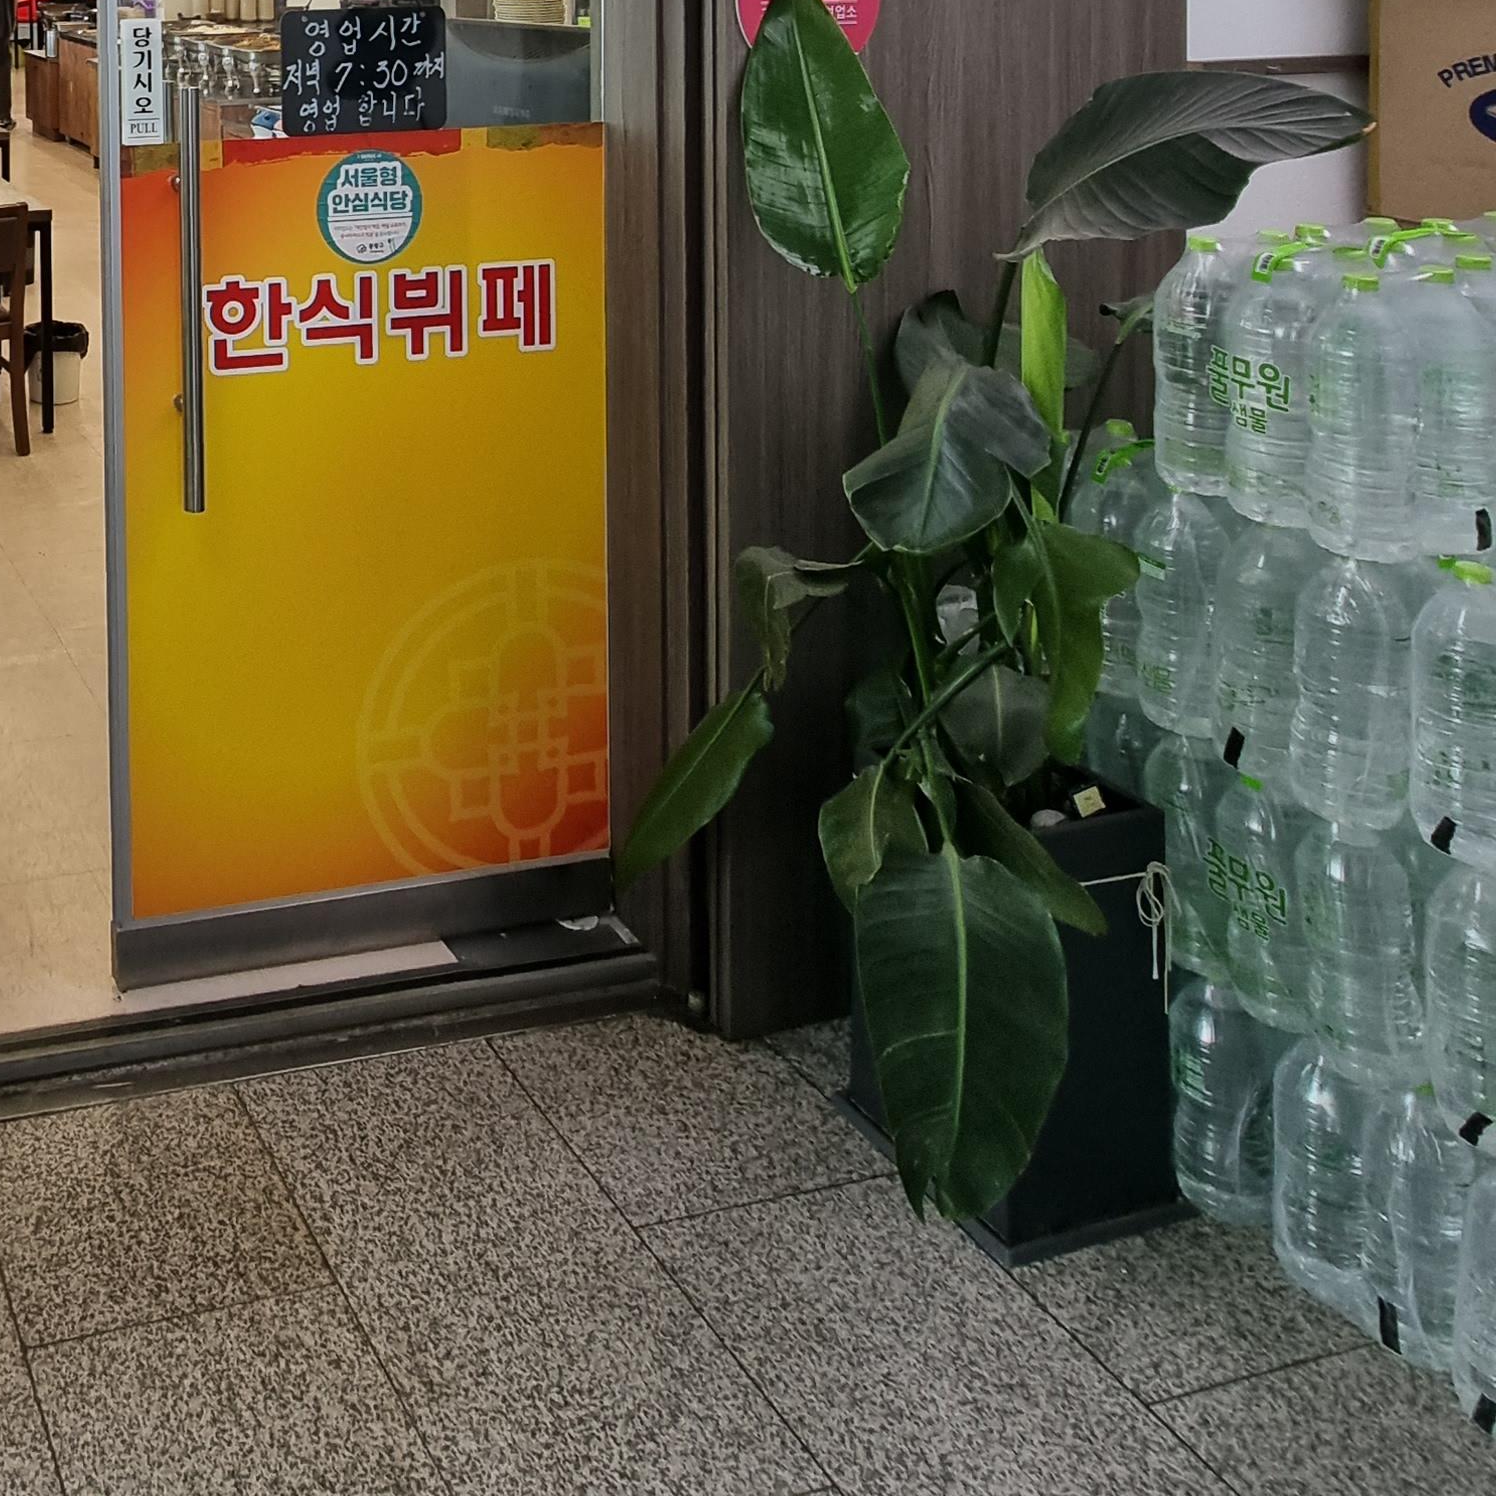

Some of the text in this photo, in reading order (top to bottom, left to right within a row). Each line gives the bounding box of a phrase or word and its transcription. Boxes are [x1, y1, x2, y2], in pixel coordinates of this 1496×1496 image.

[132, 26, 154, 114] 당기시오
[283, 58, 321, 96] 저녁
[412, 52, 446, 80] 까지
[130, 122, 158, 134] PULL
[299, 96, 341, 133] 영업
[341, 165, 398, 188] 서울형
[331, 190, 409, 214] 안심식당
[204, 262, 553, 373] 한식뷔페
[1206, 345, 1290, 413] 풀무원
[1231, 400, 1268, 435] 샘물
